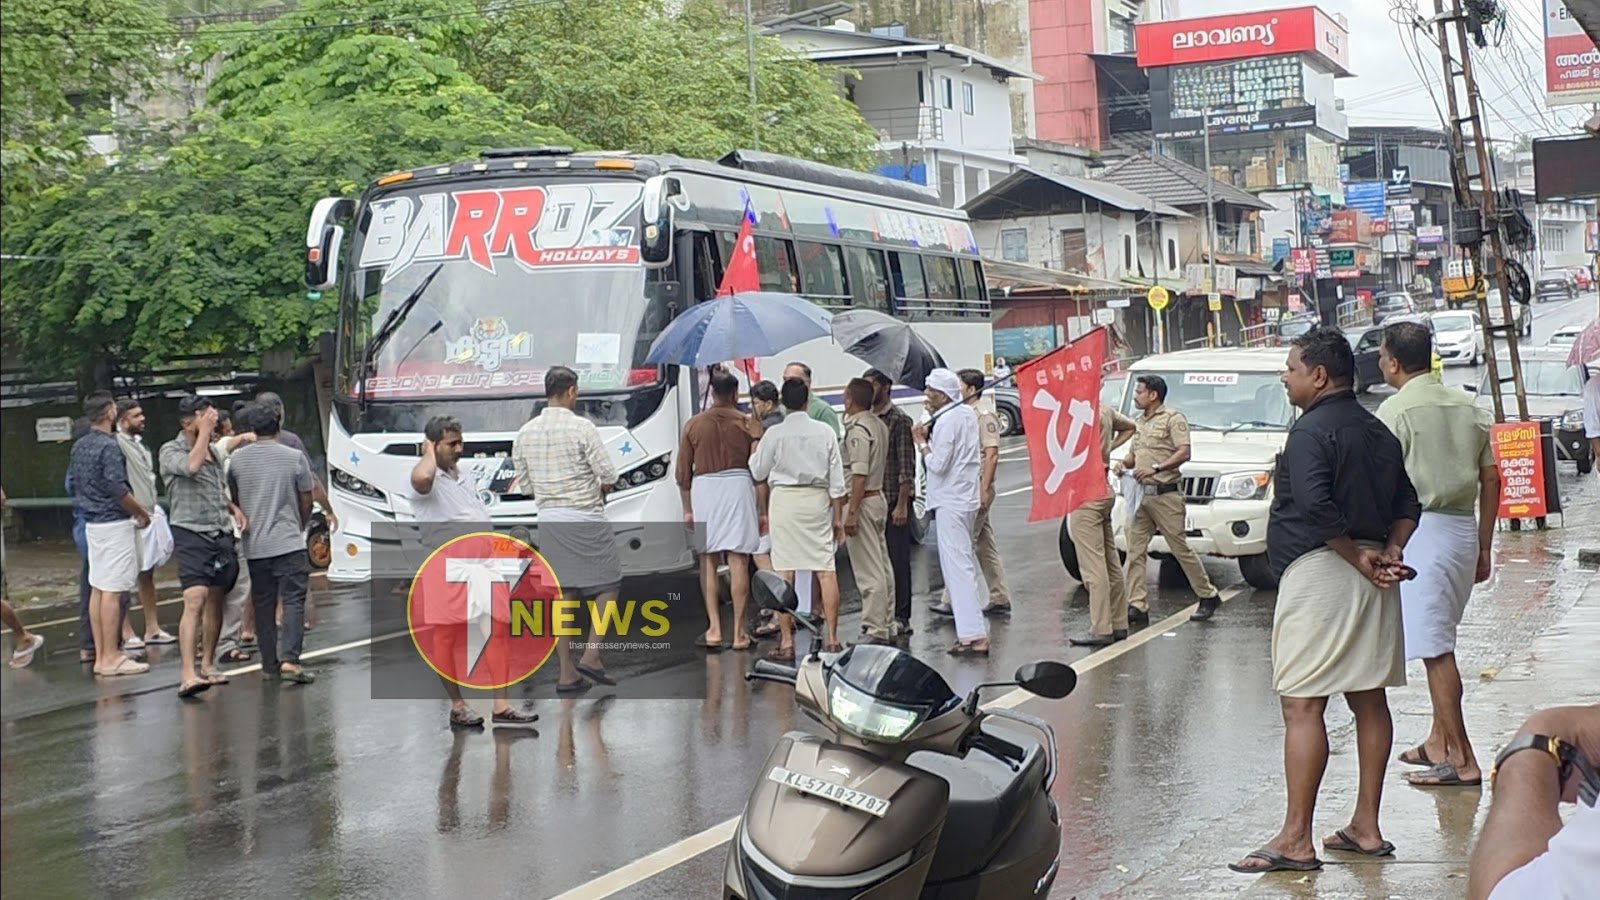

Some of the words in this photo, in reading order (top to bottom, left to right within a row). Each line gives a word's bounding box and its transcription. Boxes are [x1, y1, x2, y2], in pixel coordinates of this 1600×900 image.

[1172, 23, 1275, 49] ലാവണ്യ
[360, 184, 645, 280] BARROZ
[538, 248, 629, 263] HOLIDAYS
[1188, 375, 1234, 383] POLICE
